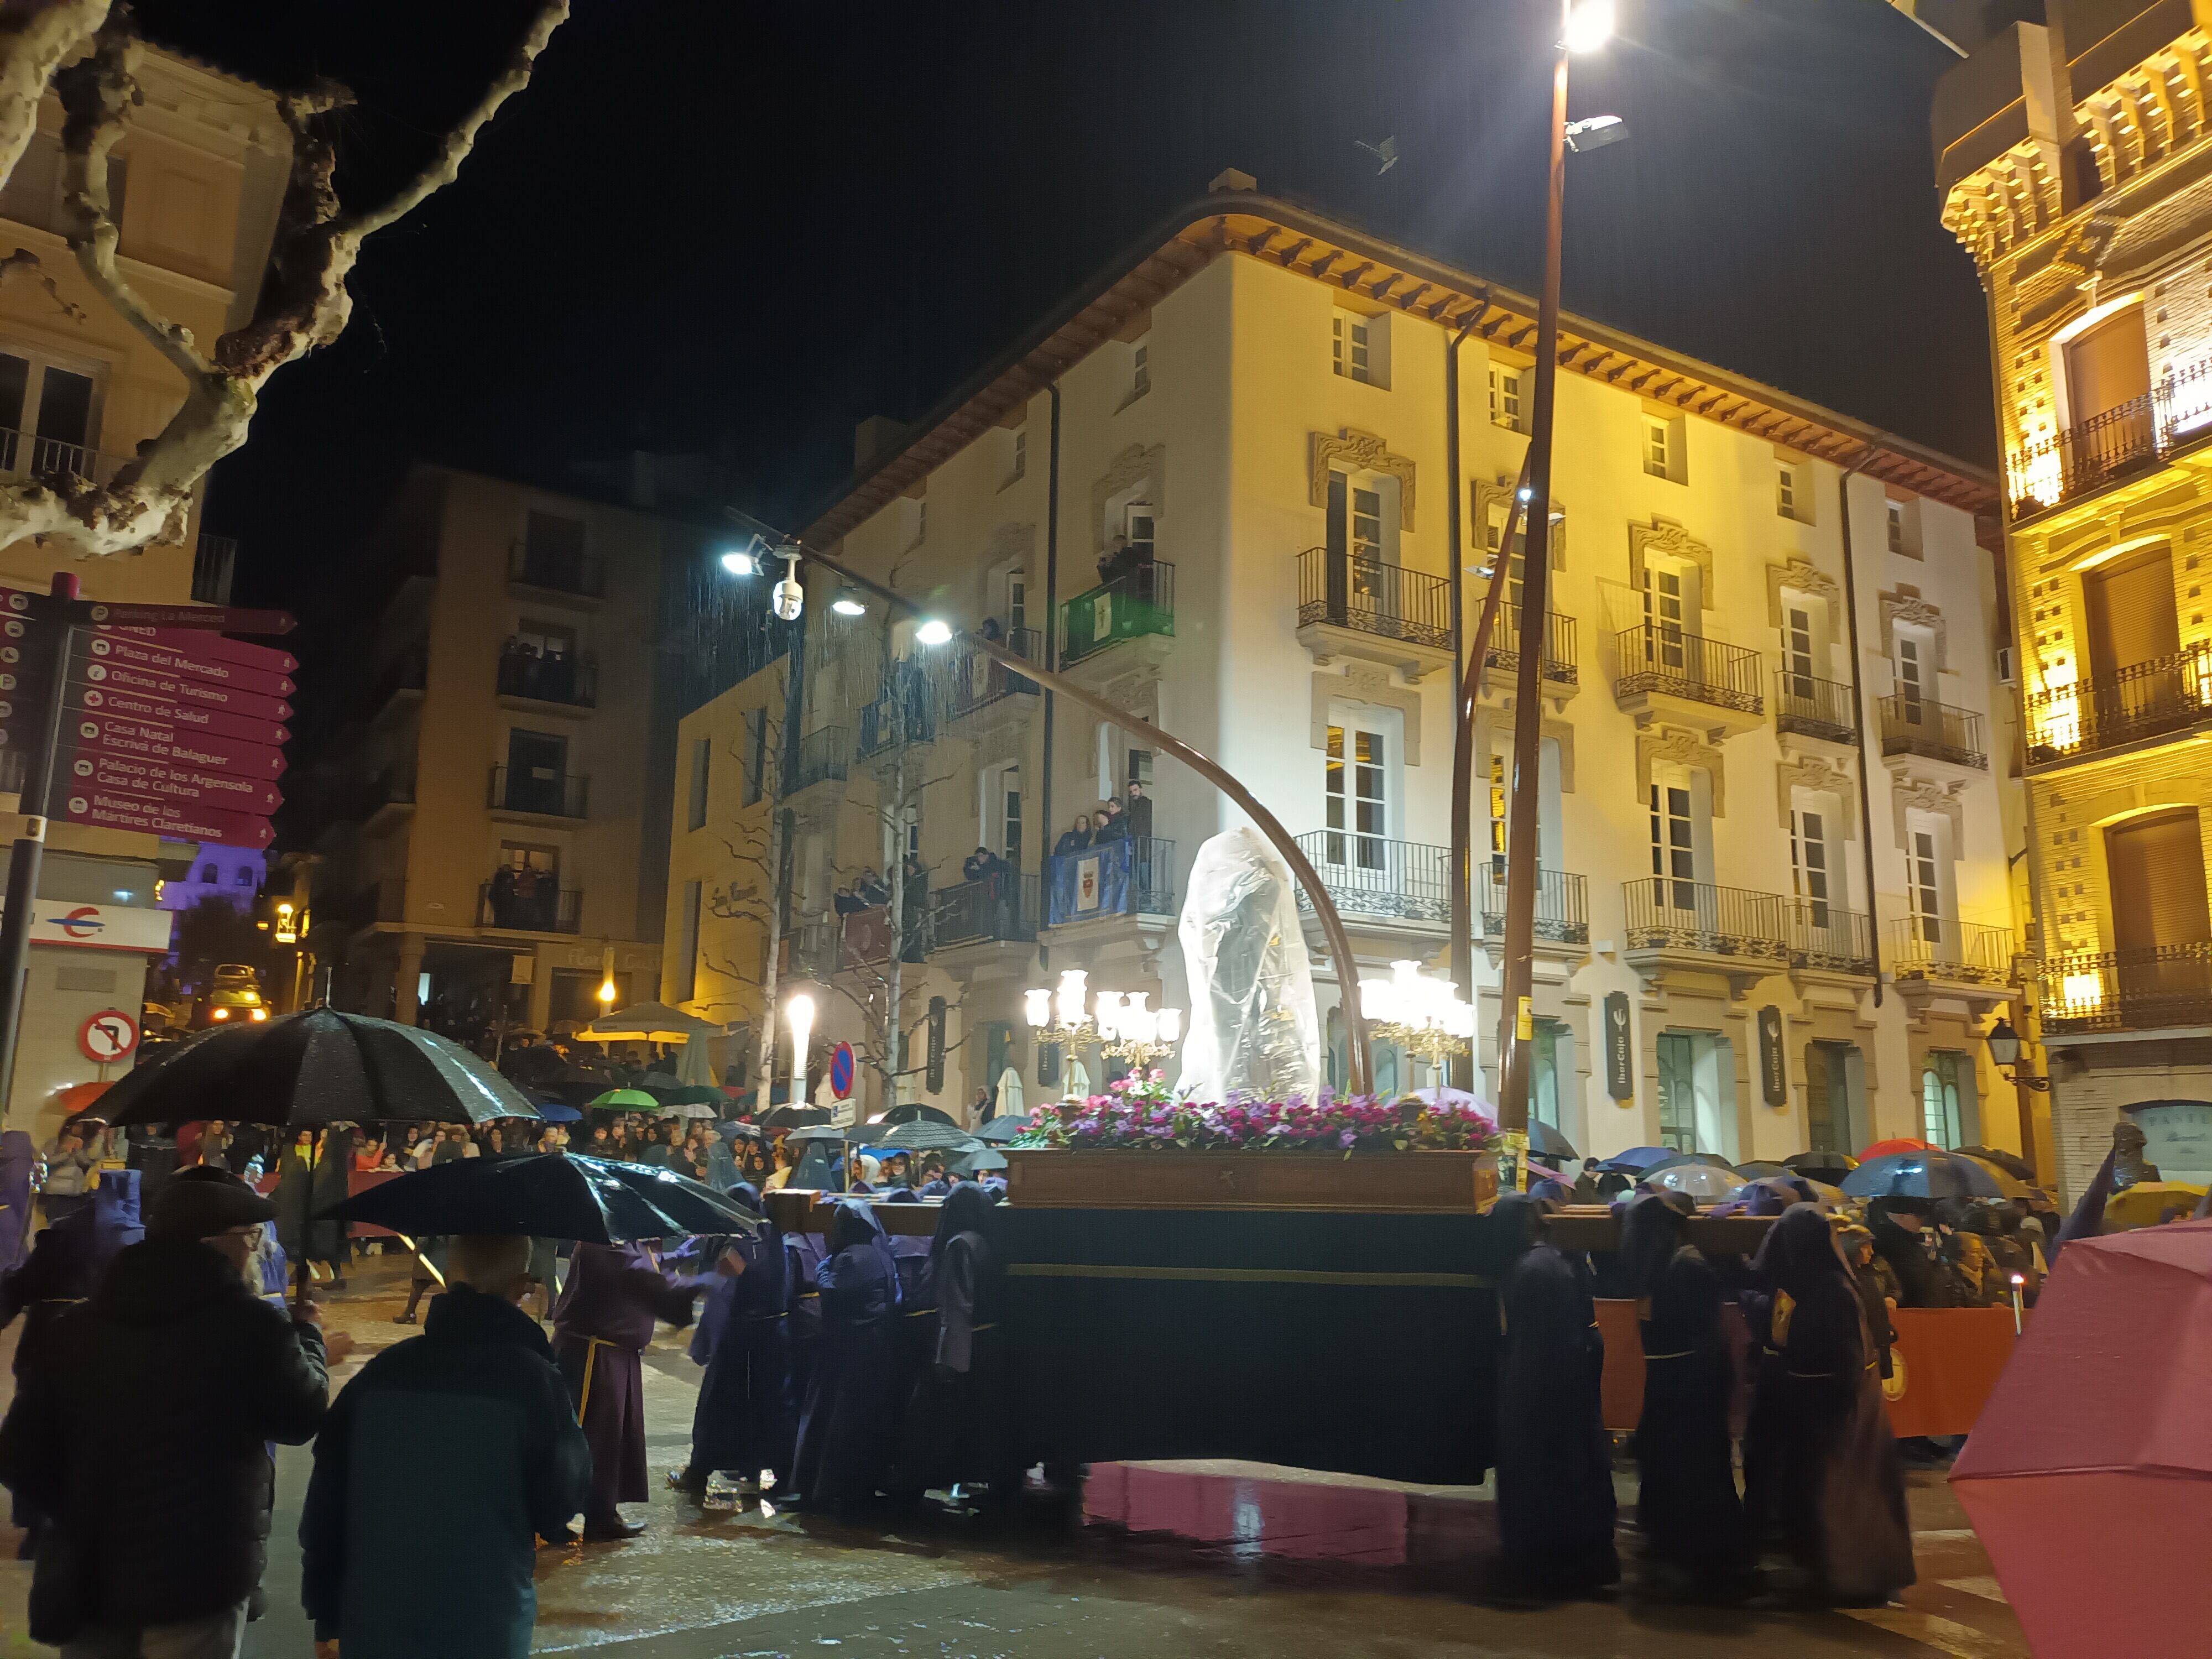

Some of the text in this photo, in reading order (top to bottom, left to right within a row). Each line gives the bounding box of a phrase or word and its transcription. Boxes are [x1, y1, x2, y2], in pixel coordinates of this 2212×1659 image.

[116, 645, 229, 677] Plaza del Mercado
[111, 671, 227, 702] Oficina de Turismo
[108, 697, 209, 724] Centro de Salud
[105, 721, 173, 742] Casa Natal
[103, 734, 228, 765] Escrivá de Balaguer
[97, 772, 199, 797] Casa de Cultura
[99, 758, 253, 792] Palacio de los Argensola
[94, 795, 181, 818] Museo de los
[92, 808, 222, 837] Mártires Claretianos
